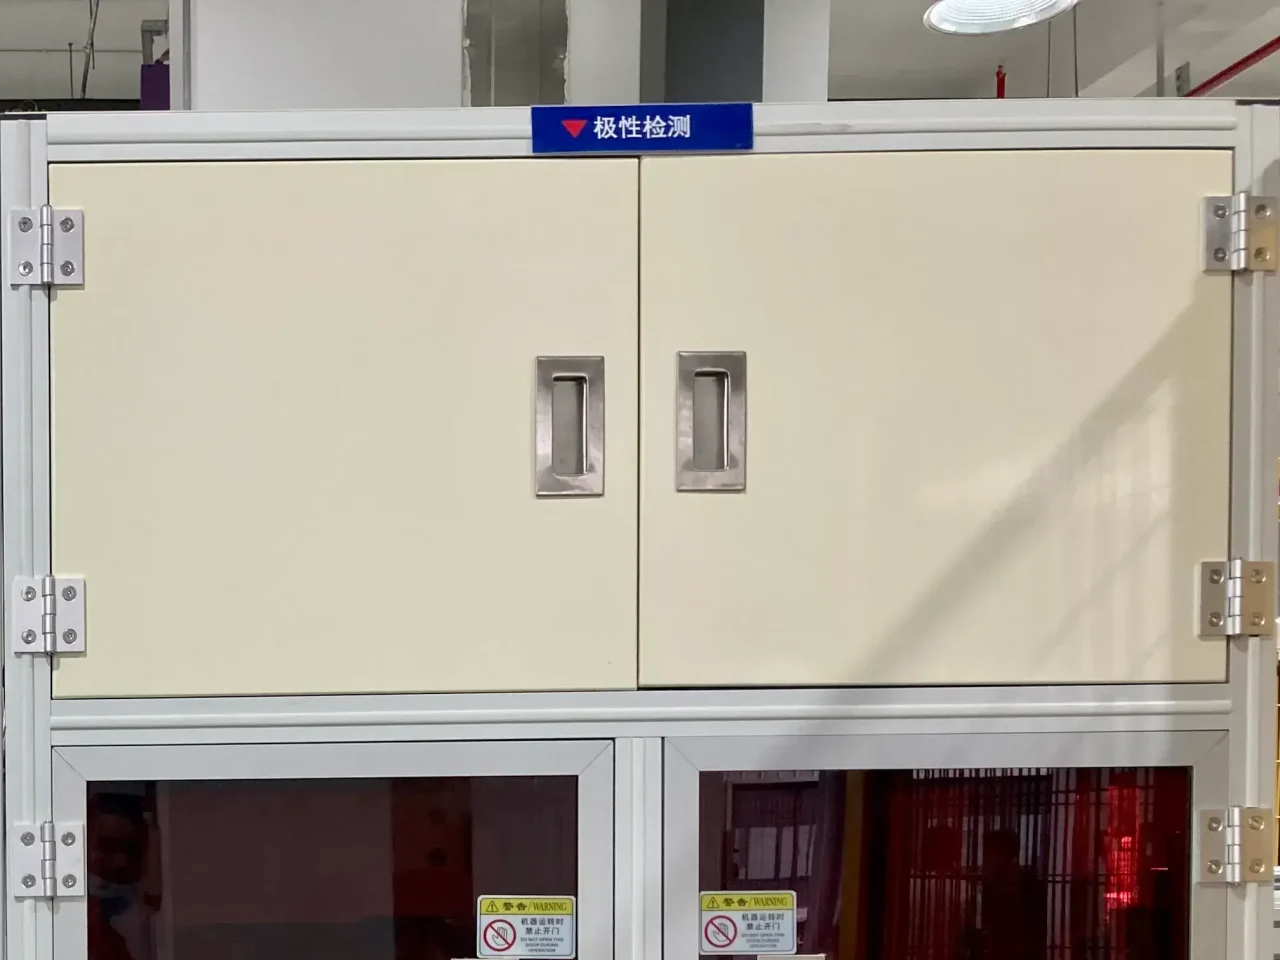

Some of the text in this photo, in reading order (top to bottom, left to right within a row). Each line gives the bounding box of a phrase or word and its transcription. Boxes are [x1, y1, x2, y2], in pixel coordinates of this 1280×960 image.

[593, 114, 692, 139] 极性检测
[521, 918, 564, 926] 机器运转时
[525, 927, 560, 935] 禁止开门
[746, 923, 780, 931] 禁止开门
